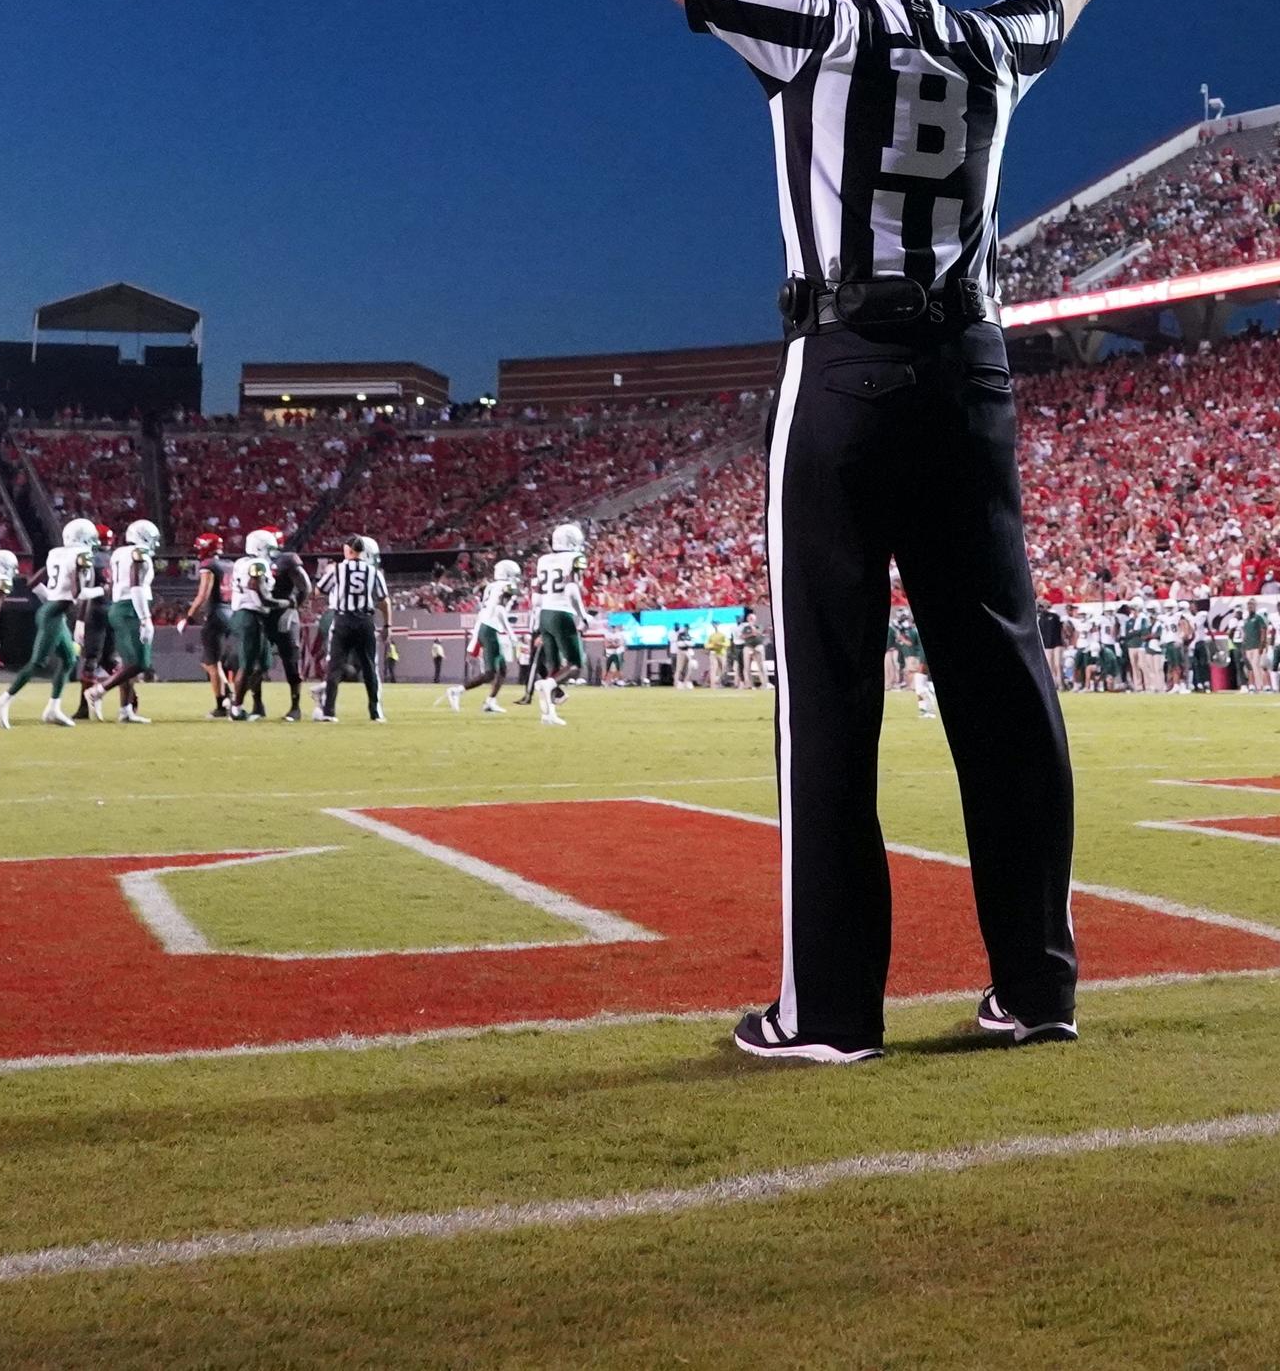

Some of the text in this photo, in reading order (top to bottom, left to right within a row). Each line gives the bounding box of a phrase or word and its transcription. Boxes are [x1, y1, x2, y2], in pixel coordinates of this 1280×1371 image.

[880, 48, 968, 179] B
[349, 571, 366, 594] S
[538, 568, 564, 594] 22
